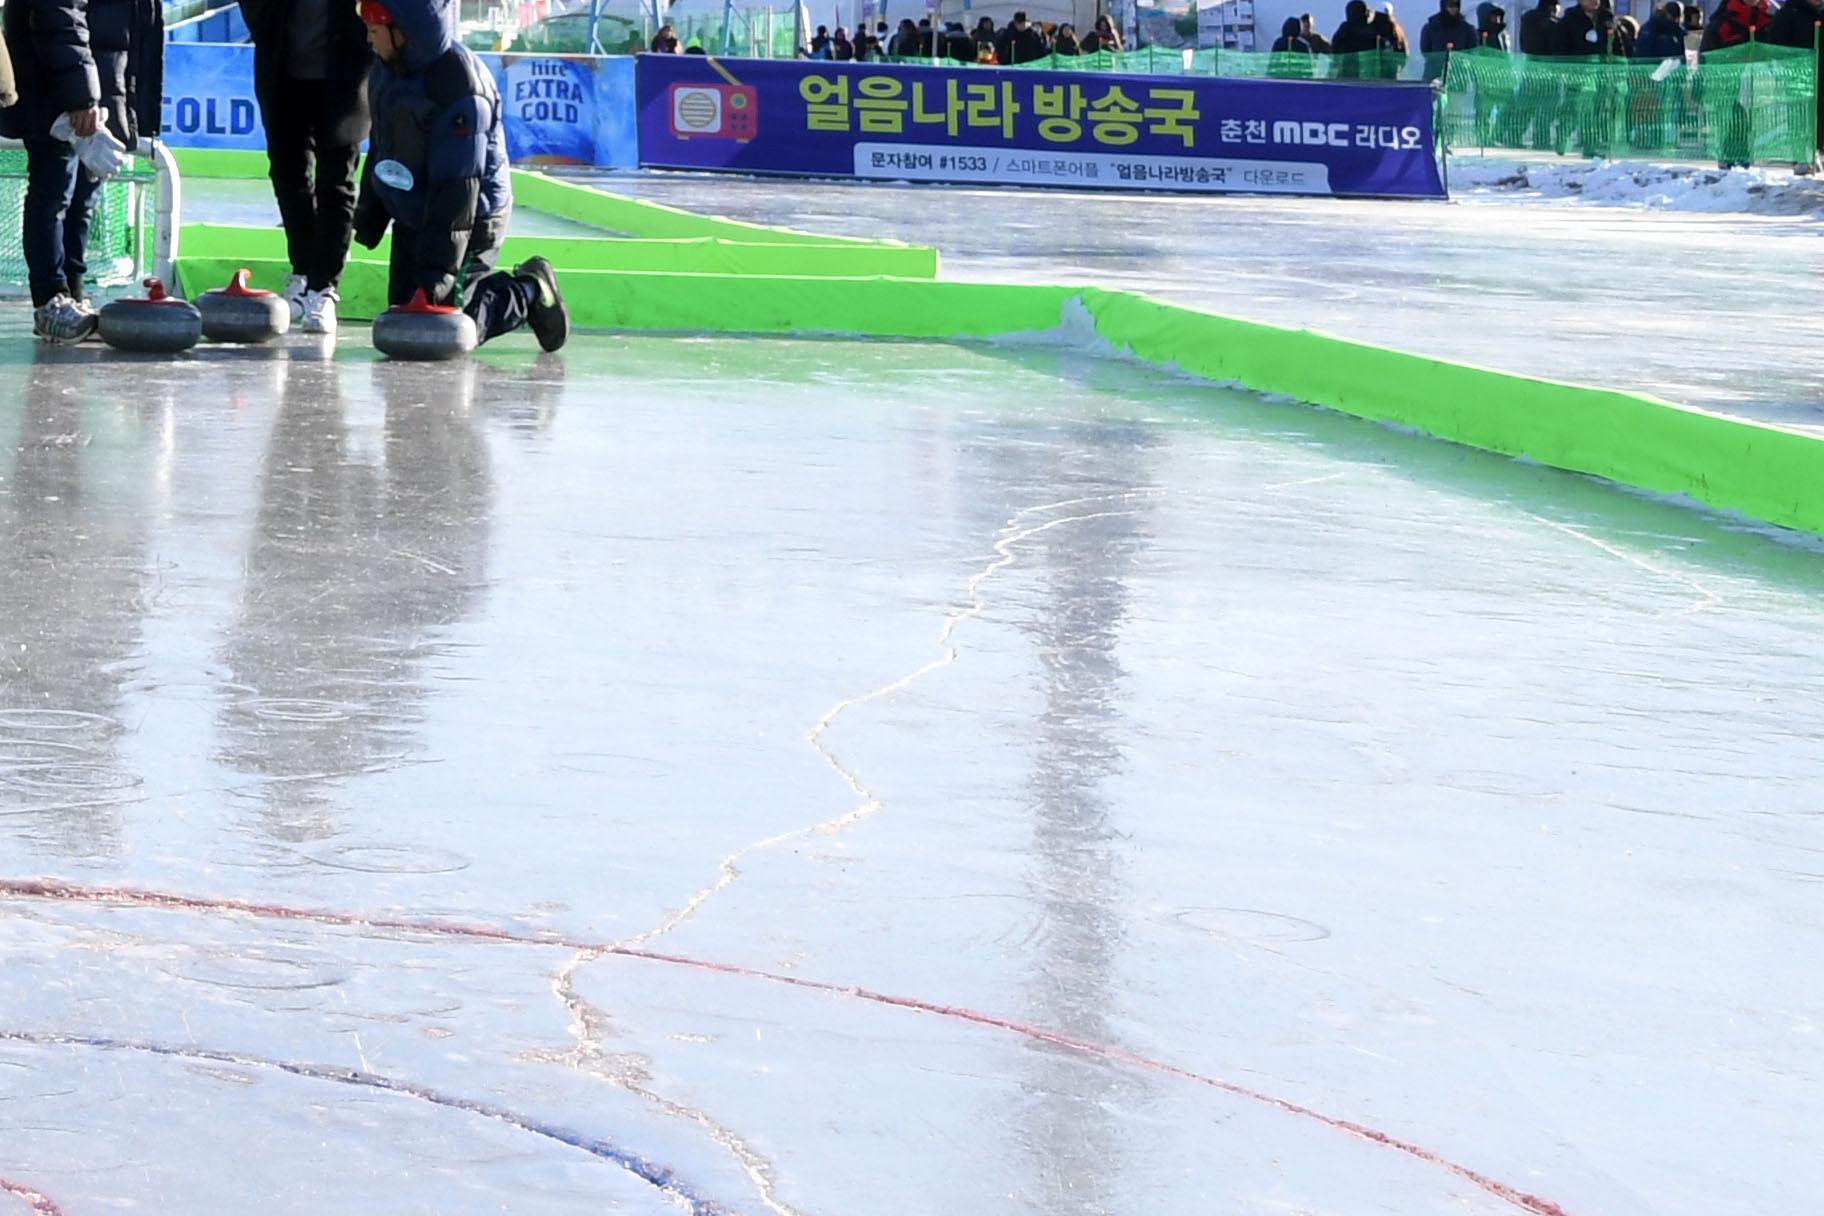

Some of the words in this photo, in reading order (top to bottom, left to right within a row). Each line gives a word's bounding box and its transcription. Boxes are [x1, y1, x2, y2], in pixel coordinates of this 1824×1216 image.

[515, 79, 584, 104] EXTRA
[521, 101, 578, 124] COLD
[799, 75, 1020, 139] 얼음나라
[1033, 84, 1200, 147] 방송국
[1220, 119, 1266, 143] 춘천
[1355, 125, 1422, 150] 라디오
[871, 151, 932, 169] 문자참여
[940, 155, 987, 171] #1533
[1243, 169, 1304, 185] 다운로드
